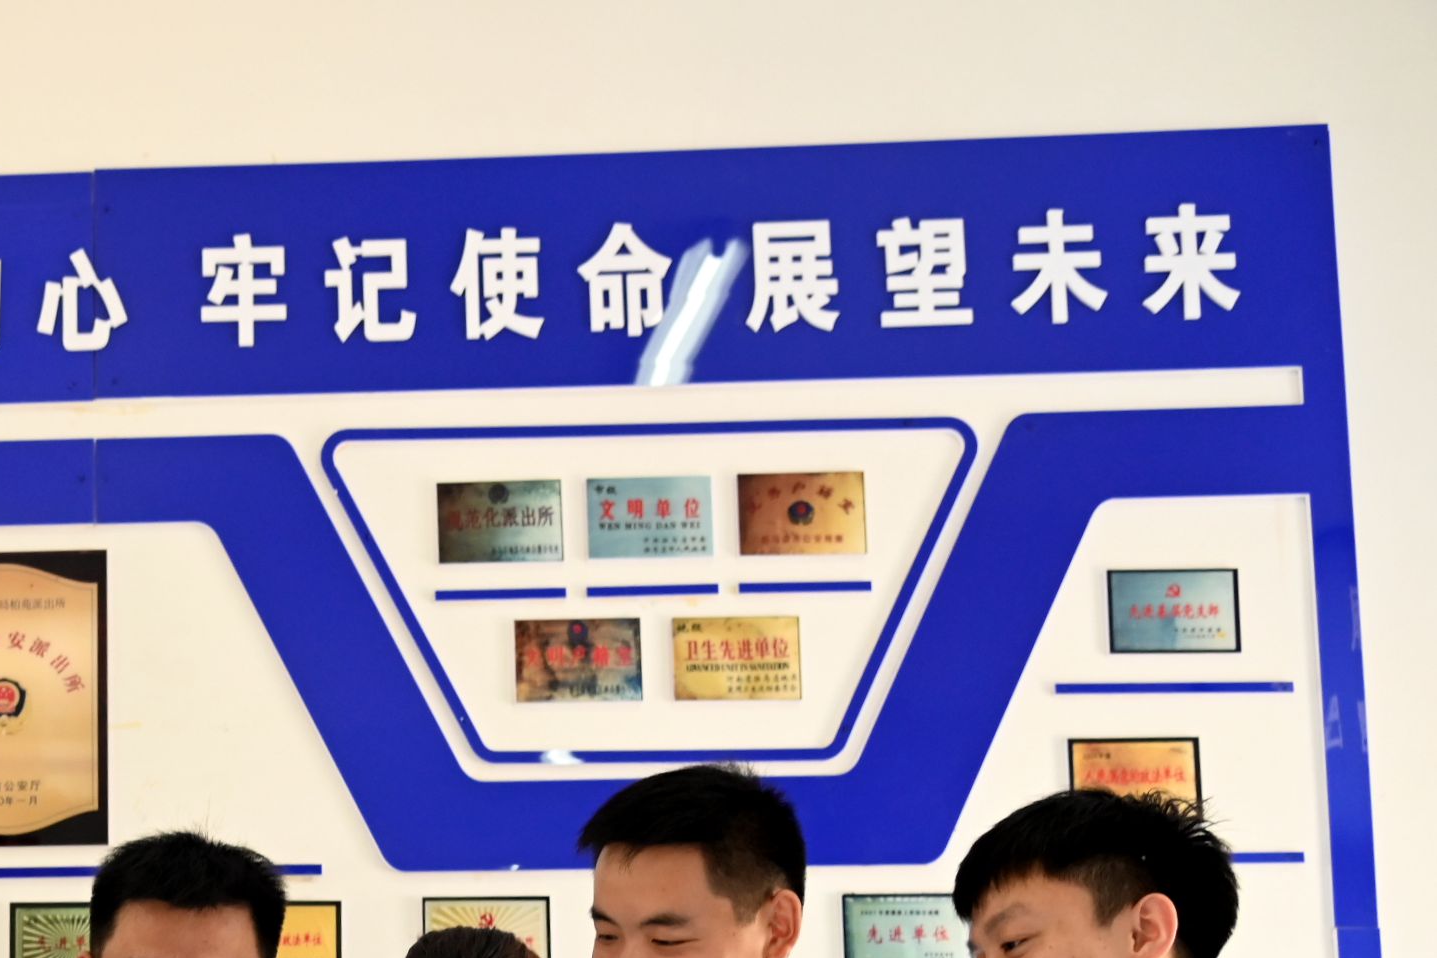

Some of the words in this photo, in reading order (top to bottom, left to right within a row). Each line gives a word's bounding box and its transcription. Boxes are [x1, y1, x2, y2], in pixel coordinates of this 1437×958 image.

[199, 221, 675, 348] 牢记使命
[745, 202, 1241, 333] 展望未来
[599, 498, 701, 521] 文明单位
[686, 638, 790, 662] 卫生先进单位
[866, 923, 951, 945] 先进单位
